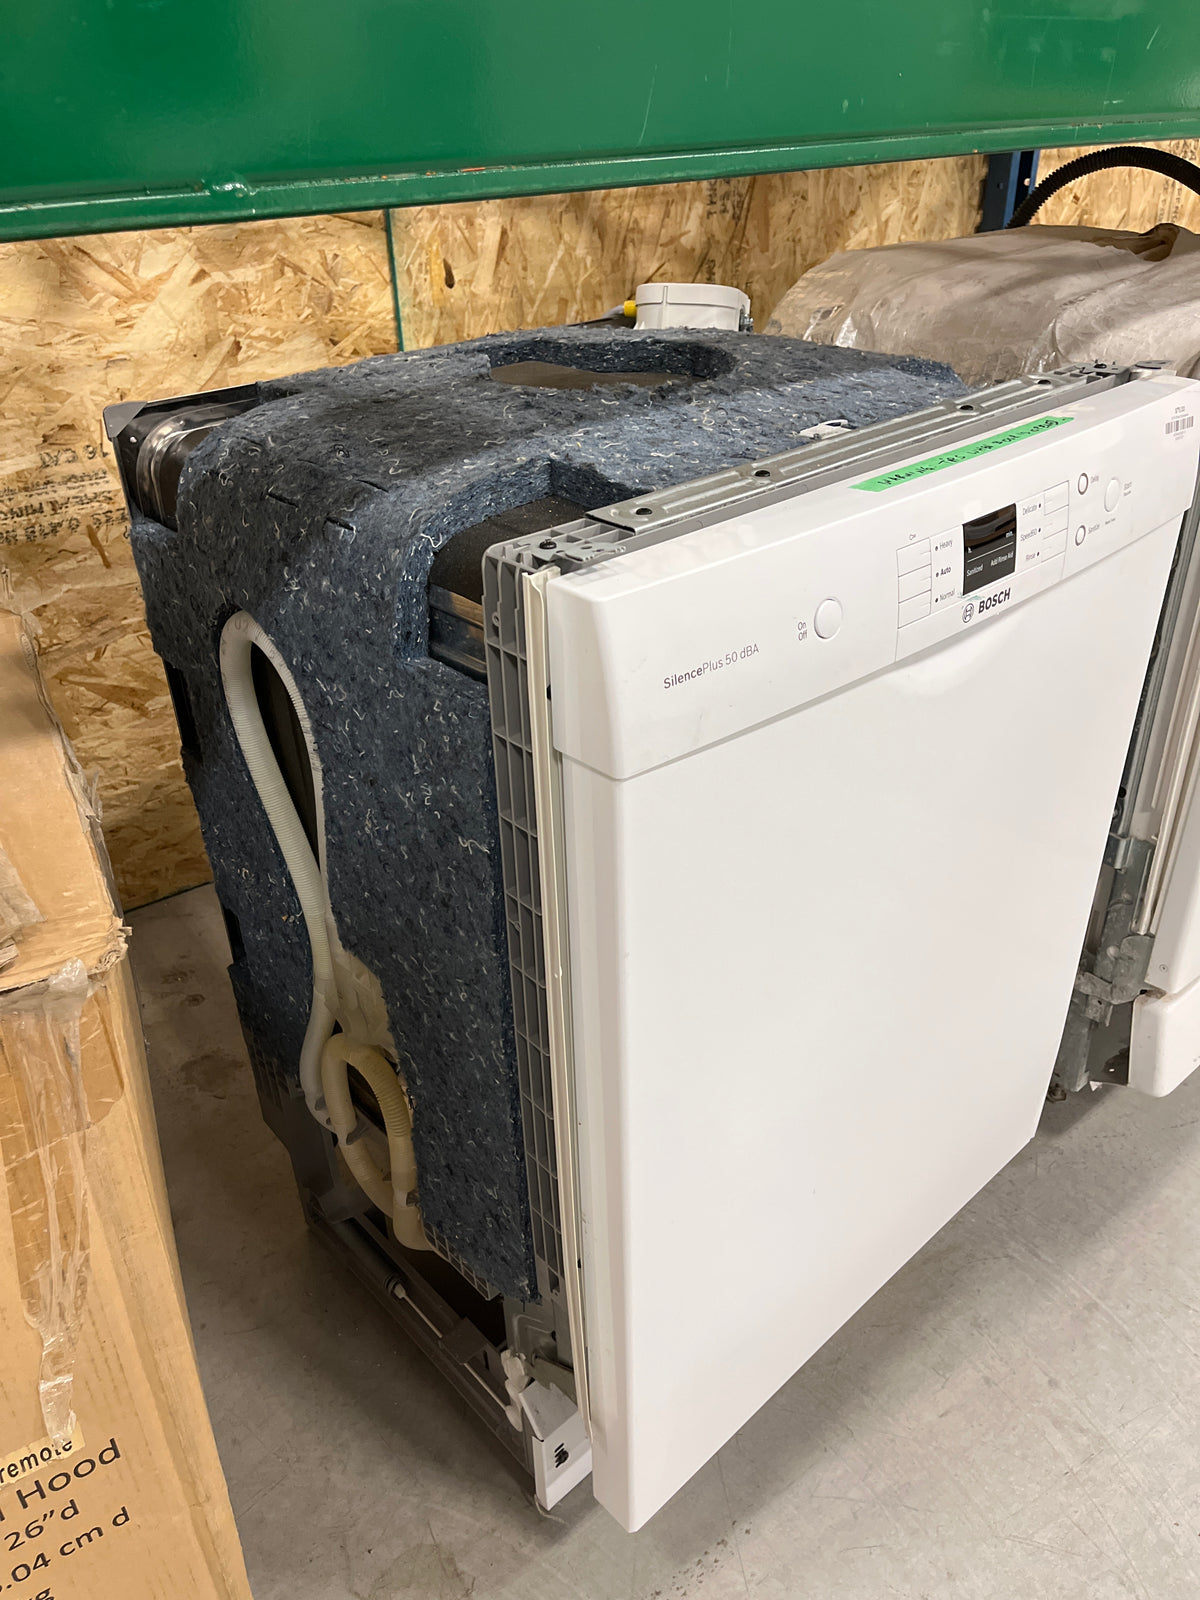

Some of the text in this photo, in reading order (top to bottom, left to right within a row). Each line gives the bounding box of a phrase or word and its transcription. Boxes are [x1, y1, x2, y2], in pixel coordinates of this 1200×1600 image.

[939, 540, 953, 550] Heavy
[940, 566, 952, 577] Auto
[939, 589, 956, 601] Normal
[978, 587, 1011, 614] BOSCH
[797, 621, 807, 631] On
[797, 630, 808, 642] Off
[663, 643, 760, 690] SilencePlus 50 dBA
[16, 1437, 121, 1510] Hood
[0, 1552, 51, 1593] .04
[59, 1526, 104, 1557] cm
[112, 1505, 130, 1528] d
